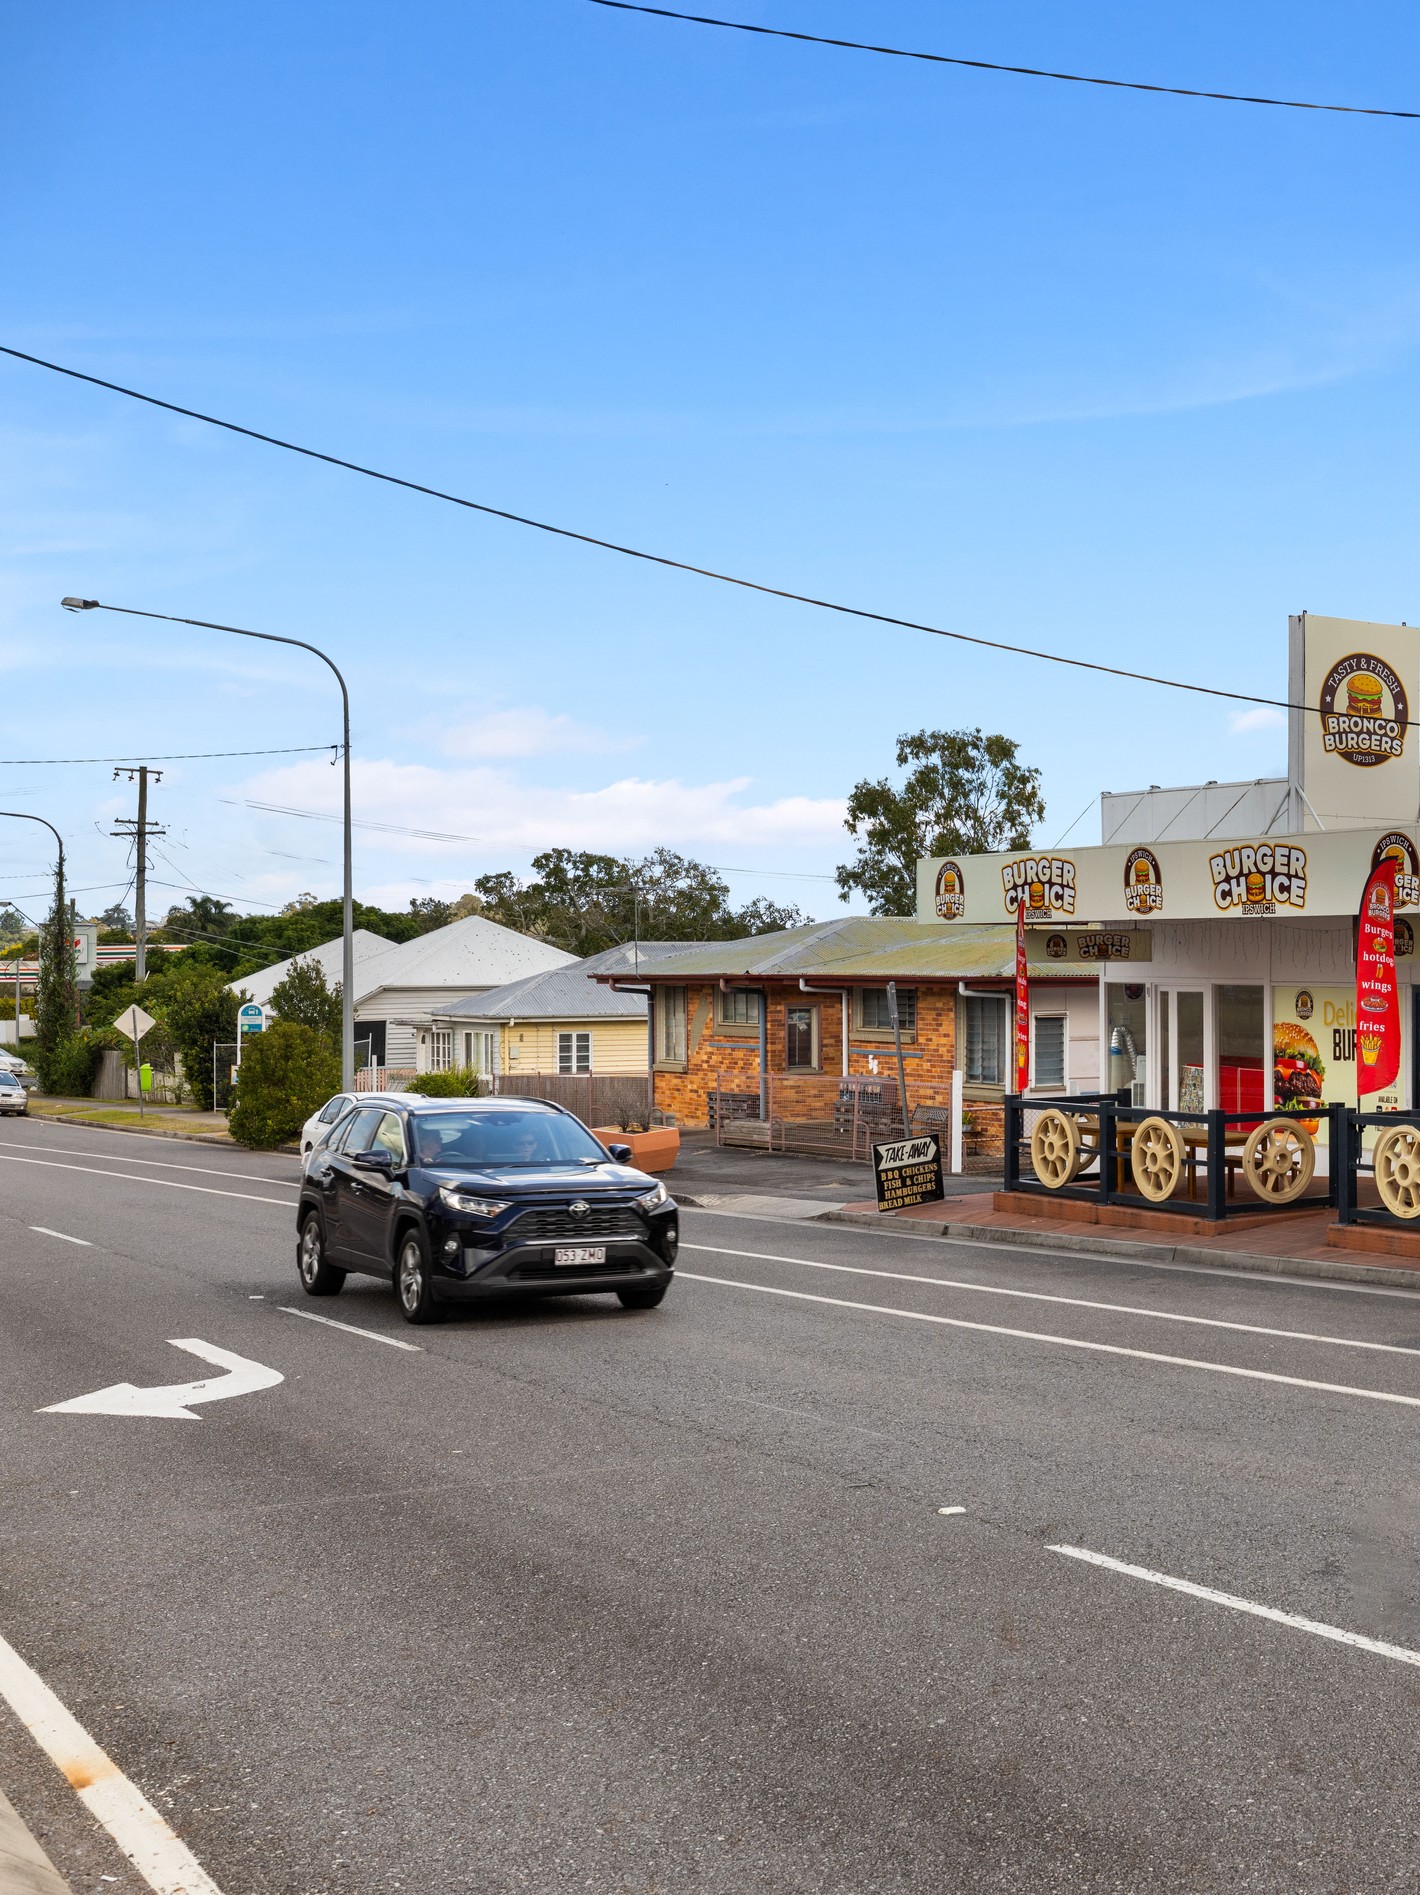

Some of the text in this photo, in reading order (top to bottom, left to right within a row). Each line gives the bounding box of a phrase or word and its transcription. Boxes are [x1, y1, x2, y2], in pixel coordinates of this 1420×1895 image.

[1328, 658, 1401, 695] TASTY & FRESH
[1328, 717, 1398, 738] BRONCO
[1325, 733, 1402, 755] BURGERS
[1380, 835, 1410, 850] IPSWICH
[1130, 850, 1154, 864] IPSWICH
[1210, 844, 1306, 884] BURGER
[1002, 857, 1075, 891] BURGER
[1394, 874, 1420, 890] GER
[1125, 883, 1163, 899] BURGER
[935, 893, 964, 906] BURGER
[1242, 903, 1276, 915] IPSWICH
[1369, 903, 1390, 913] BRONCO
[1077, 934, 1130, 947] BURGER
[1362, 951, 1395, 968] hotdog
[1361, 980, 1392, 994] wings
[1359, 1020, 1386, 1033] fries
[884, 1140, 932, 1164] TAKE-AWAY
[901, 1162, 938, 1177] CHICKENS
[883, 1172, 936, 1190] FISH & CHIPS
[884, 1182, 936, 1200] HAMBURGERS
[878, 1194, 923, 1210] BREAD MILK
